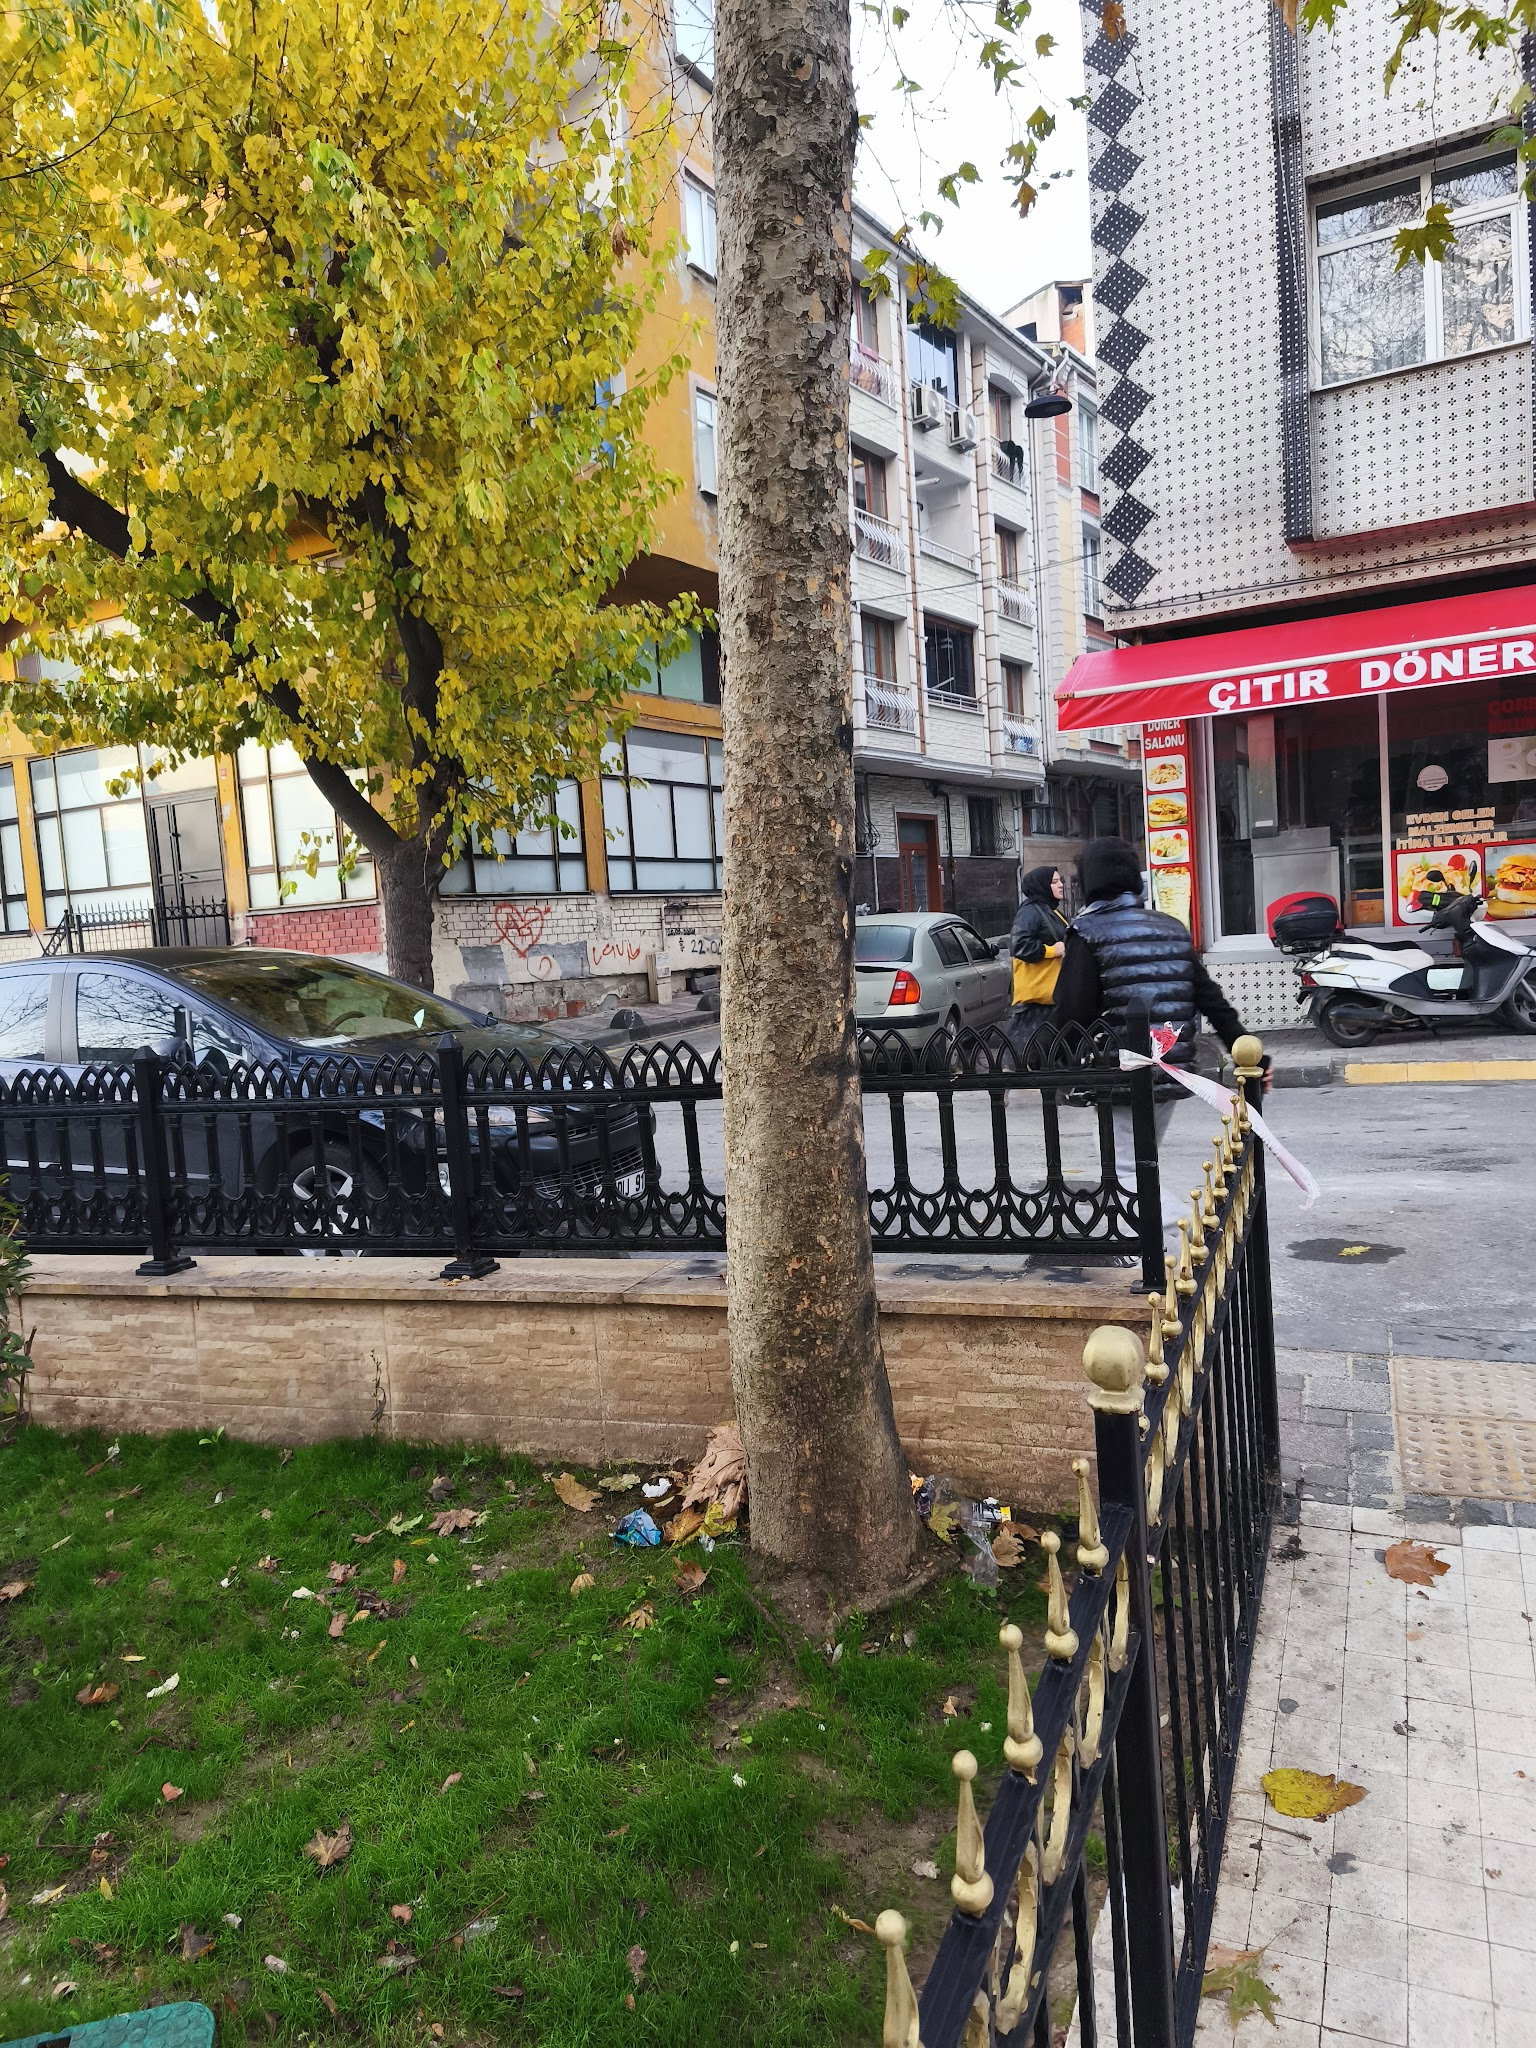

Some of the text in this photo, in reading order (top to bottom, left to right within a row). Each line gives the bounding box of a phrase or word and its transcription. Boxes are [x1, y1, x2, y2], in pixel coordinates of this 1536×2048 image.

[1208, 640, 1536, 713] ÇITIR DÖNER
[1145, 734, 1185, 751] SALONU
[1405, 811, 1449, 825] EVDEN
[1408, 820, 1495, 837] MALZEMELER
